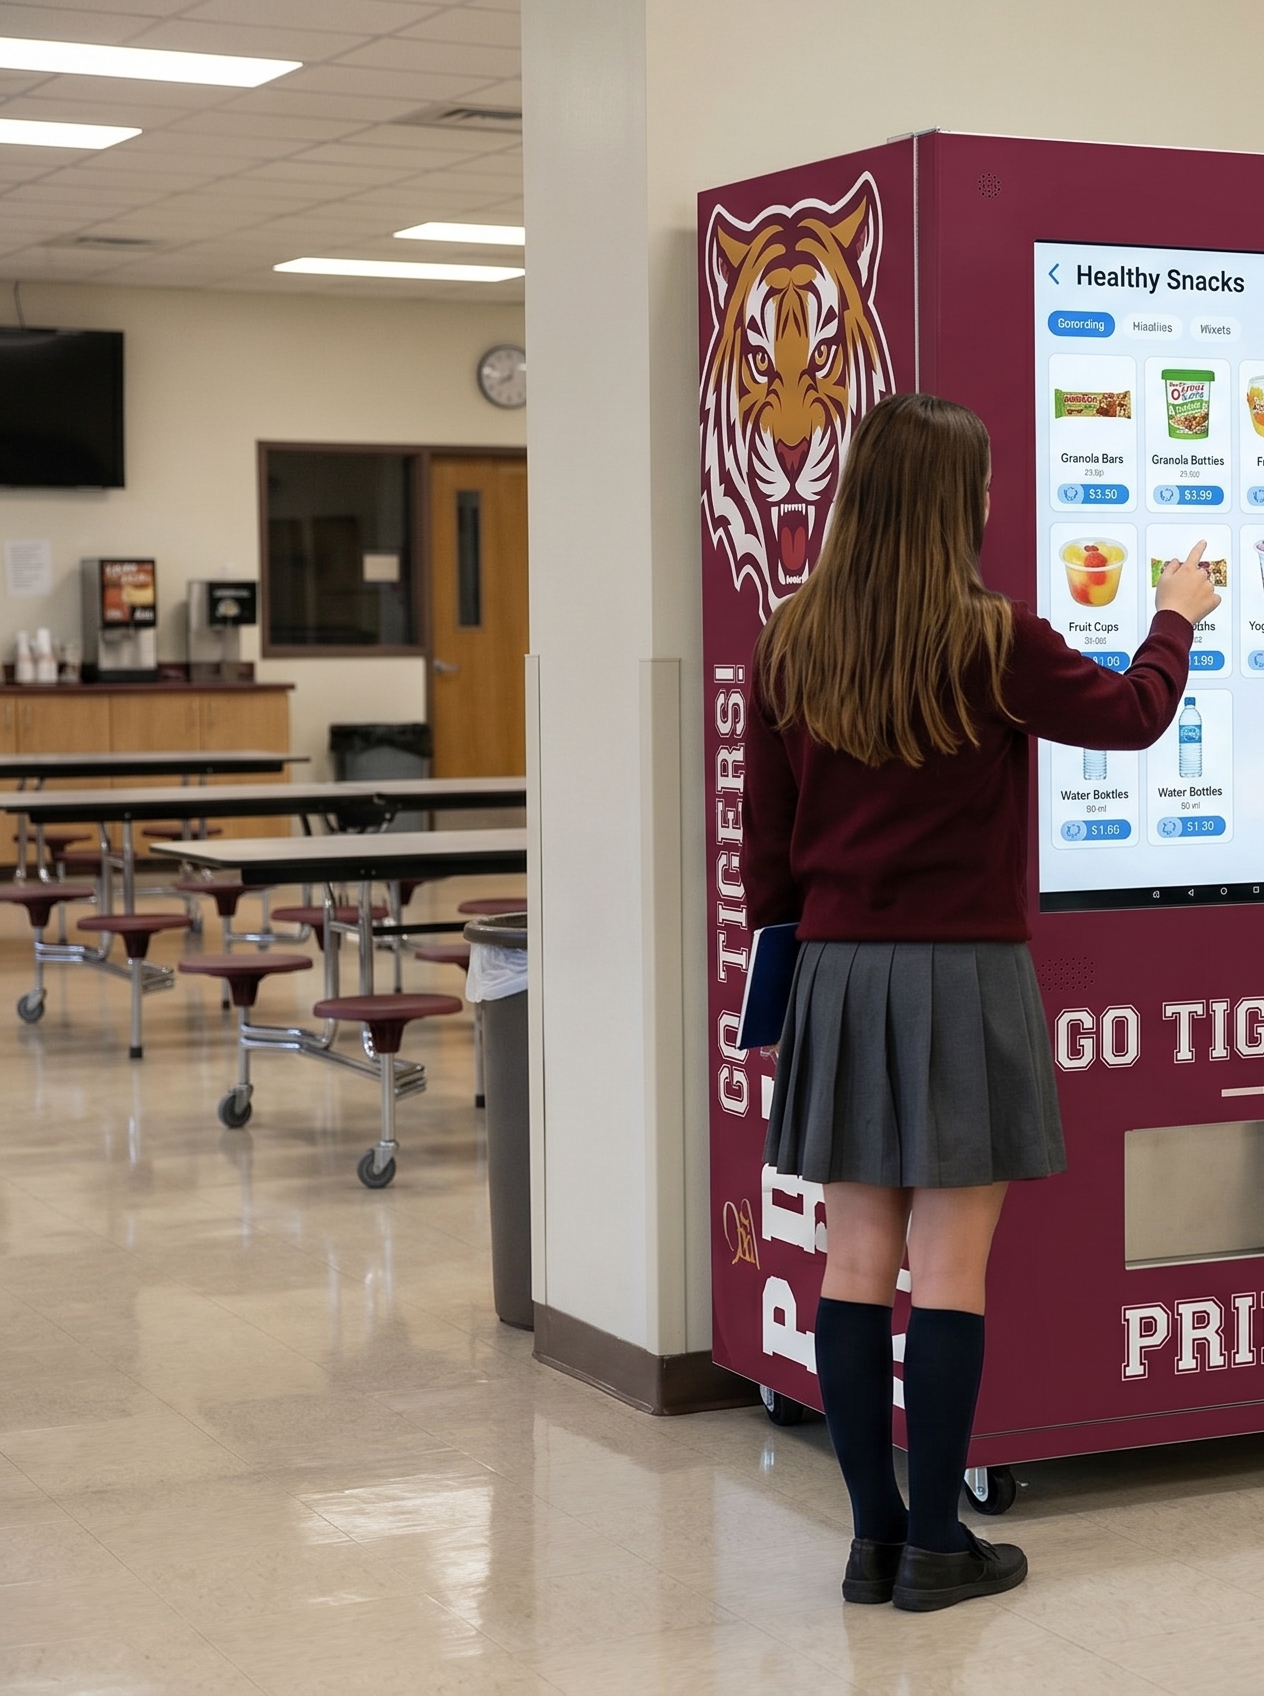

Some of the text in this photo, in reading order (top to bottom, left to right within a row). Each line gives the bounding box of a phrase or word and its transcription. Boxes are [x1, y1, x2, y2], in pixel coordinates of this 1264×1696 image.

[1076, 264, 1246, 294] Healthy Snacks
[1060, 452, 1124, 464] Granola Bars
[1151, 454, 1189, 465] Granola
[1089, 488, 1118, 499] $3.50
[1184, 490, 1213, 501] $3.99
[1068, 621, 1119, 634] Fruit Cups
[1060, 790, 1091, 801] Water
[1157, 785, 1223, 798] Water Bottles
[713, 664, 750, 1119] GO TIGERS!
[1054, 1004, 1141, 1072] GO
